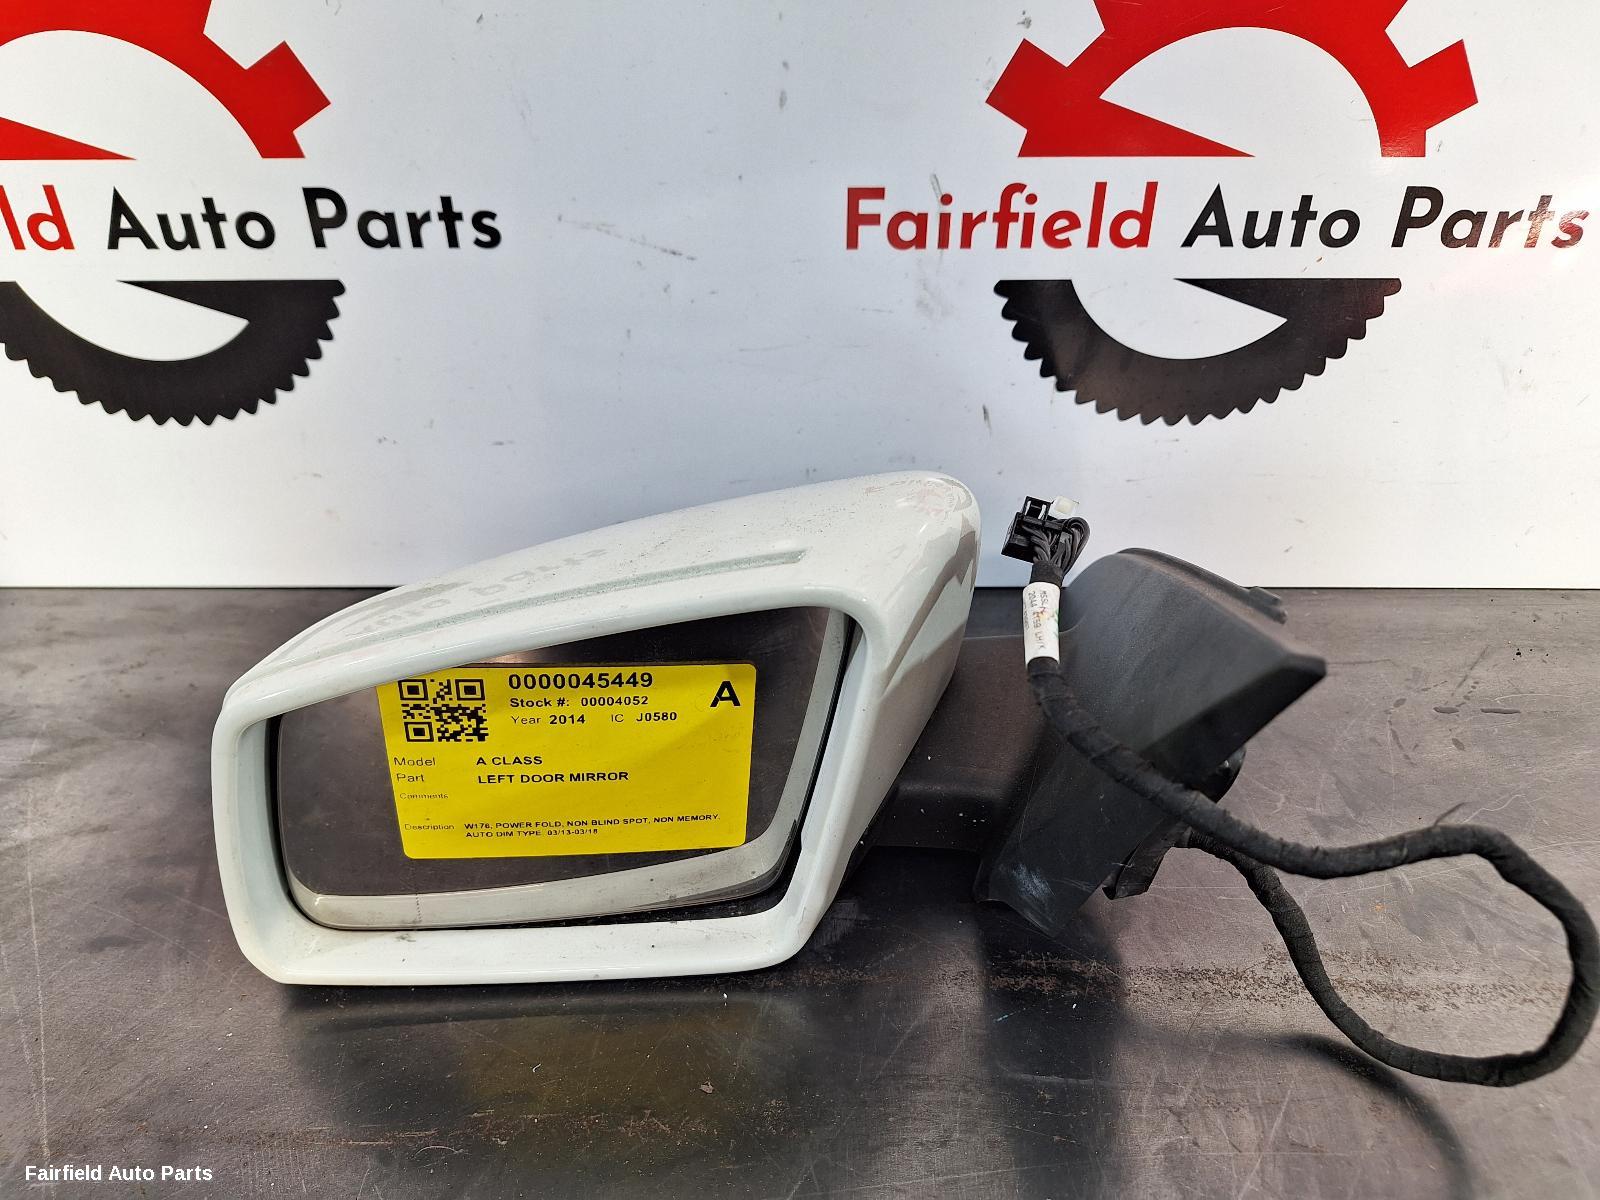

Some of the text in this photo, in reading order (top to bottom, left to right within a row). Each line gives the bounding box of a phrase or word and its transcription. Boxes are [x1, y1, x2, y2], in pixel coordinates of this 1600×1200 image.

[108, 187, 275, 250] Auto
[302, 187, 502, 250] Parts
[847, 182, 1589, 250] Fairfield Auto Parts
[508, 671, 653, 690] 0000045449
[709, 680, 741, 708] A
[509, 695, 649, 708] Stock #: 00004052
[510, 711, 678, 725] Year 2014 IC J0580
[393, 755, 543, 767] Model A CLASS
[396, 771, 629, 784] Part LEFT DOOR MIRROR
[399, 792, 449, 800] Comments
[404, 823, 455, 831] Description
[495, 821, 533, 829] POWER
[566, 820, 588, 828] NON
[591, 818, 620, 827] BLIND
[653, 816, 675, 824] NON
[465, 831, 494, 839] AUTO
[496, 830, 514, 838] DIM
